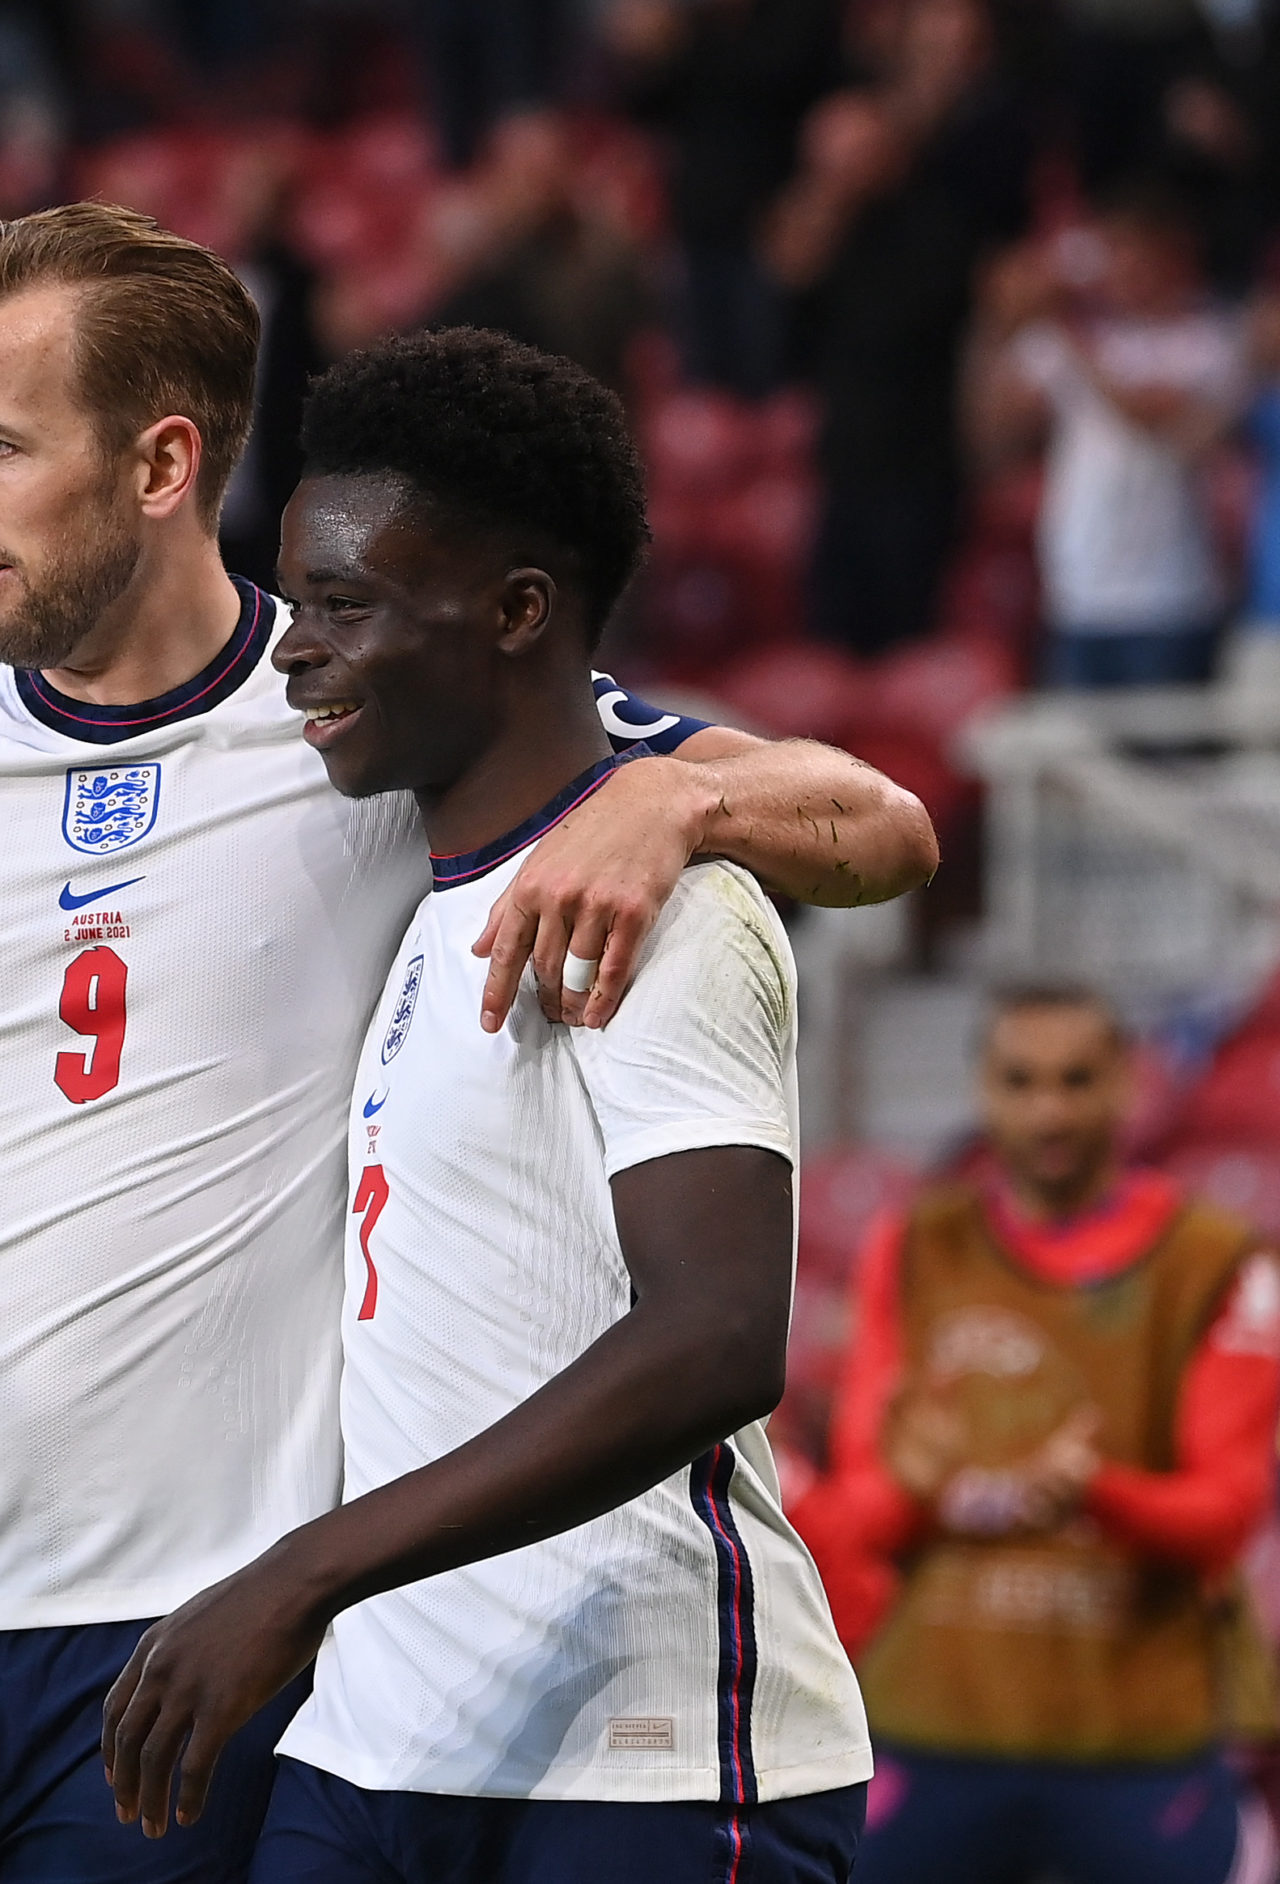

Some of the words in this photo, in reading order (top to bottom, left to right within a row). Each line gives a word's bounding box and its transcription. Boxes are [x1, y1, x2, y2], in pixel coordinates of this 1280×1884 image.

[596, 691, 680, 739] C
[64, 929, 70, 942] 2
[74, 927, 103, 941] JUNE
[107, 925, 130, 938] 2021
[72, 911, 122, 926] AUSTRIA
[54, 946, 128, 1104] 9
[352, 1164, 389, 1320] 7
